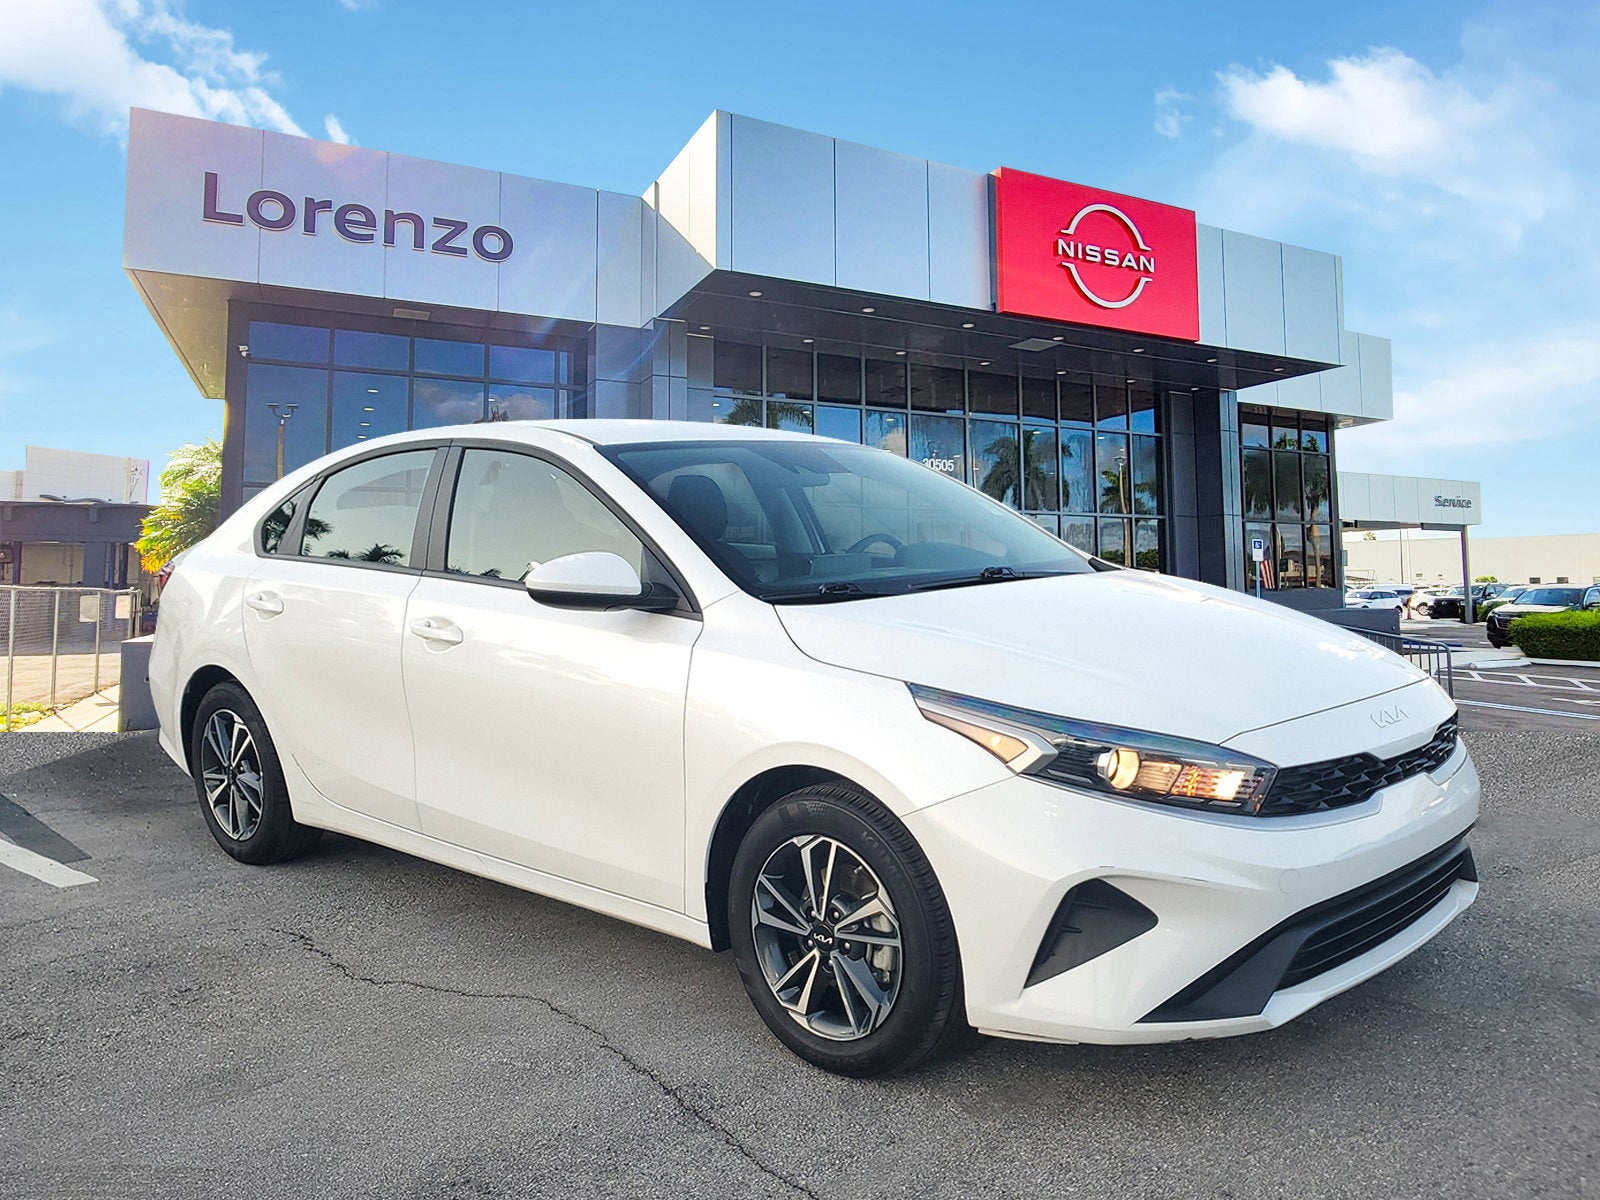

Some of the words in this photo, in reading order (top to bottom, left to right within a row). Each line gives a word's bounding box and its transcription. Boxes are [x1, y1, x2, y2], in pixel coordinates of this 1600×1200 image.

[202, 171, 514, 262] Lorenzo
[1057, 238, 1155, 273] NISSAN
[1434, 495, 1472, 508] Service
